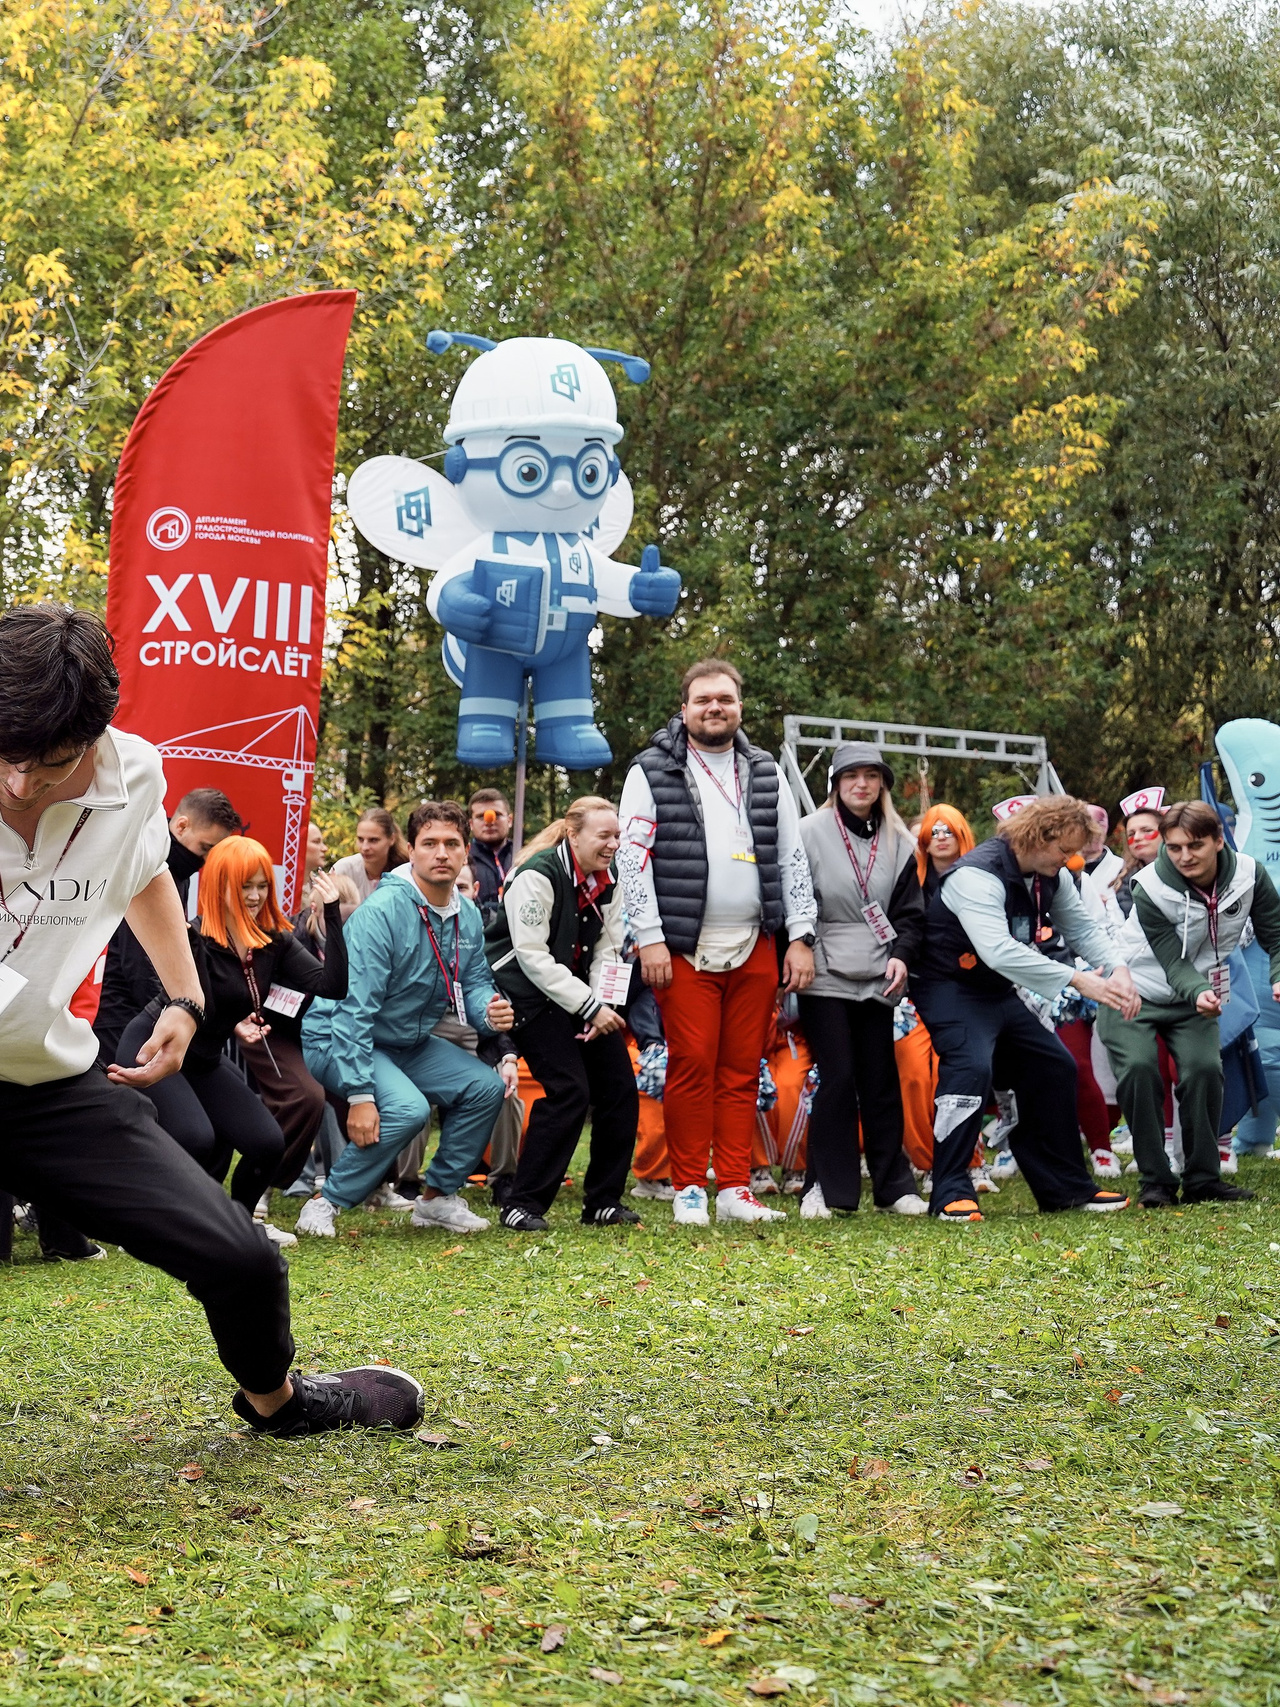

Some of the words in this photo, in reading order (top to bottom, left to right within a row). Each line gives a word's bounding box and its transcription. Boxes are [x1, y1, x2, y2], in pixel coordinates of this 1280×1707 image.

[195, 516, 247, 526] ДЕПАРТАМЕНТ
[195, 525, 275, 538] ГРАДОСТРОИТЕЛЬНОЙ
[277, 531, 314, 544] ПОЛИТИКИ
[195, 532, 226, 541] ГОРОДА
[227, 534, 261, 545] МОСКВЫ
[141, 573, 314, 645] XVIII
[138, 636, 313, 679] СТРОЙСЛЁТ
[19, 914, 88, 927] ДЕВЕЛОПМЕНТ
